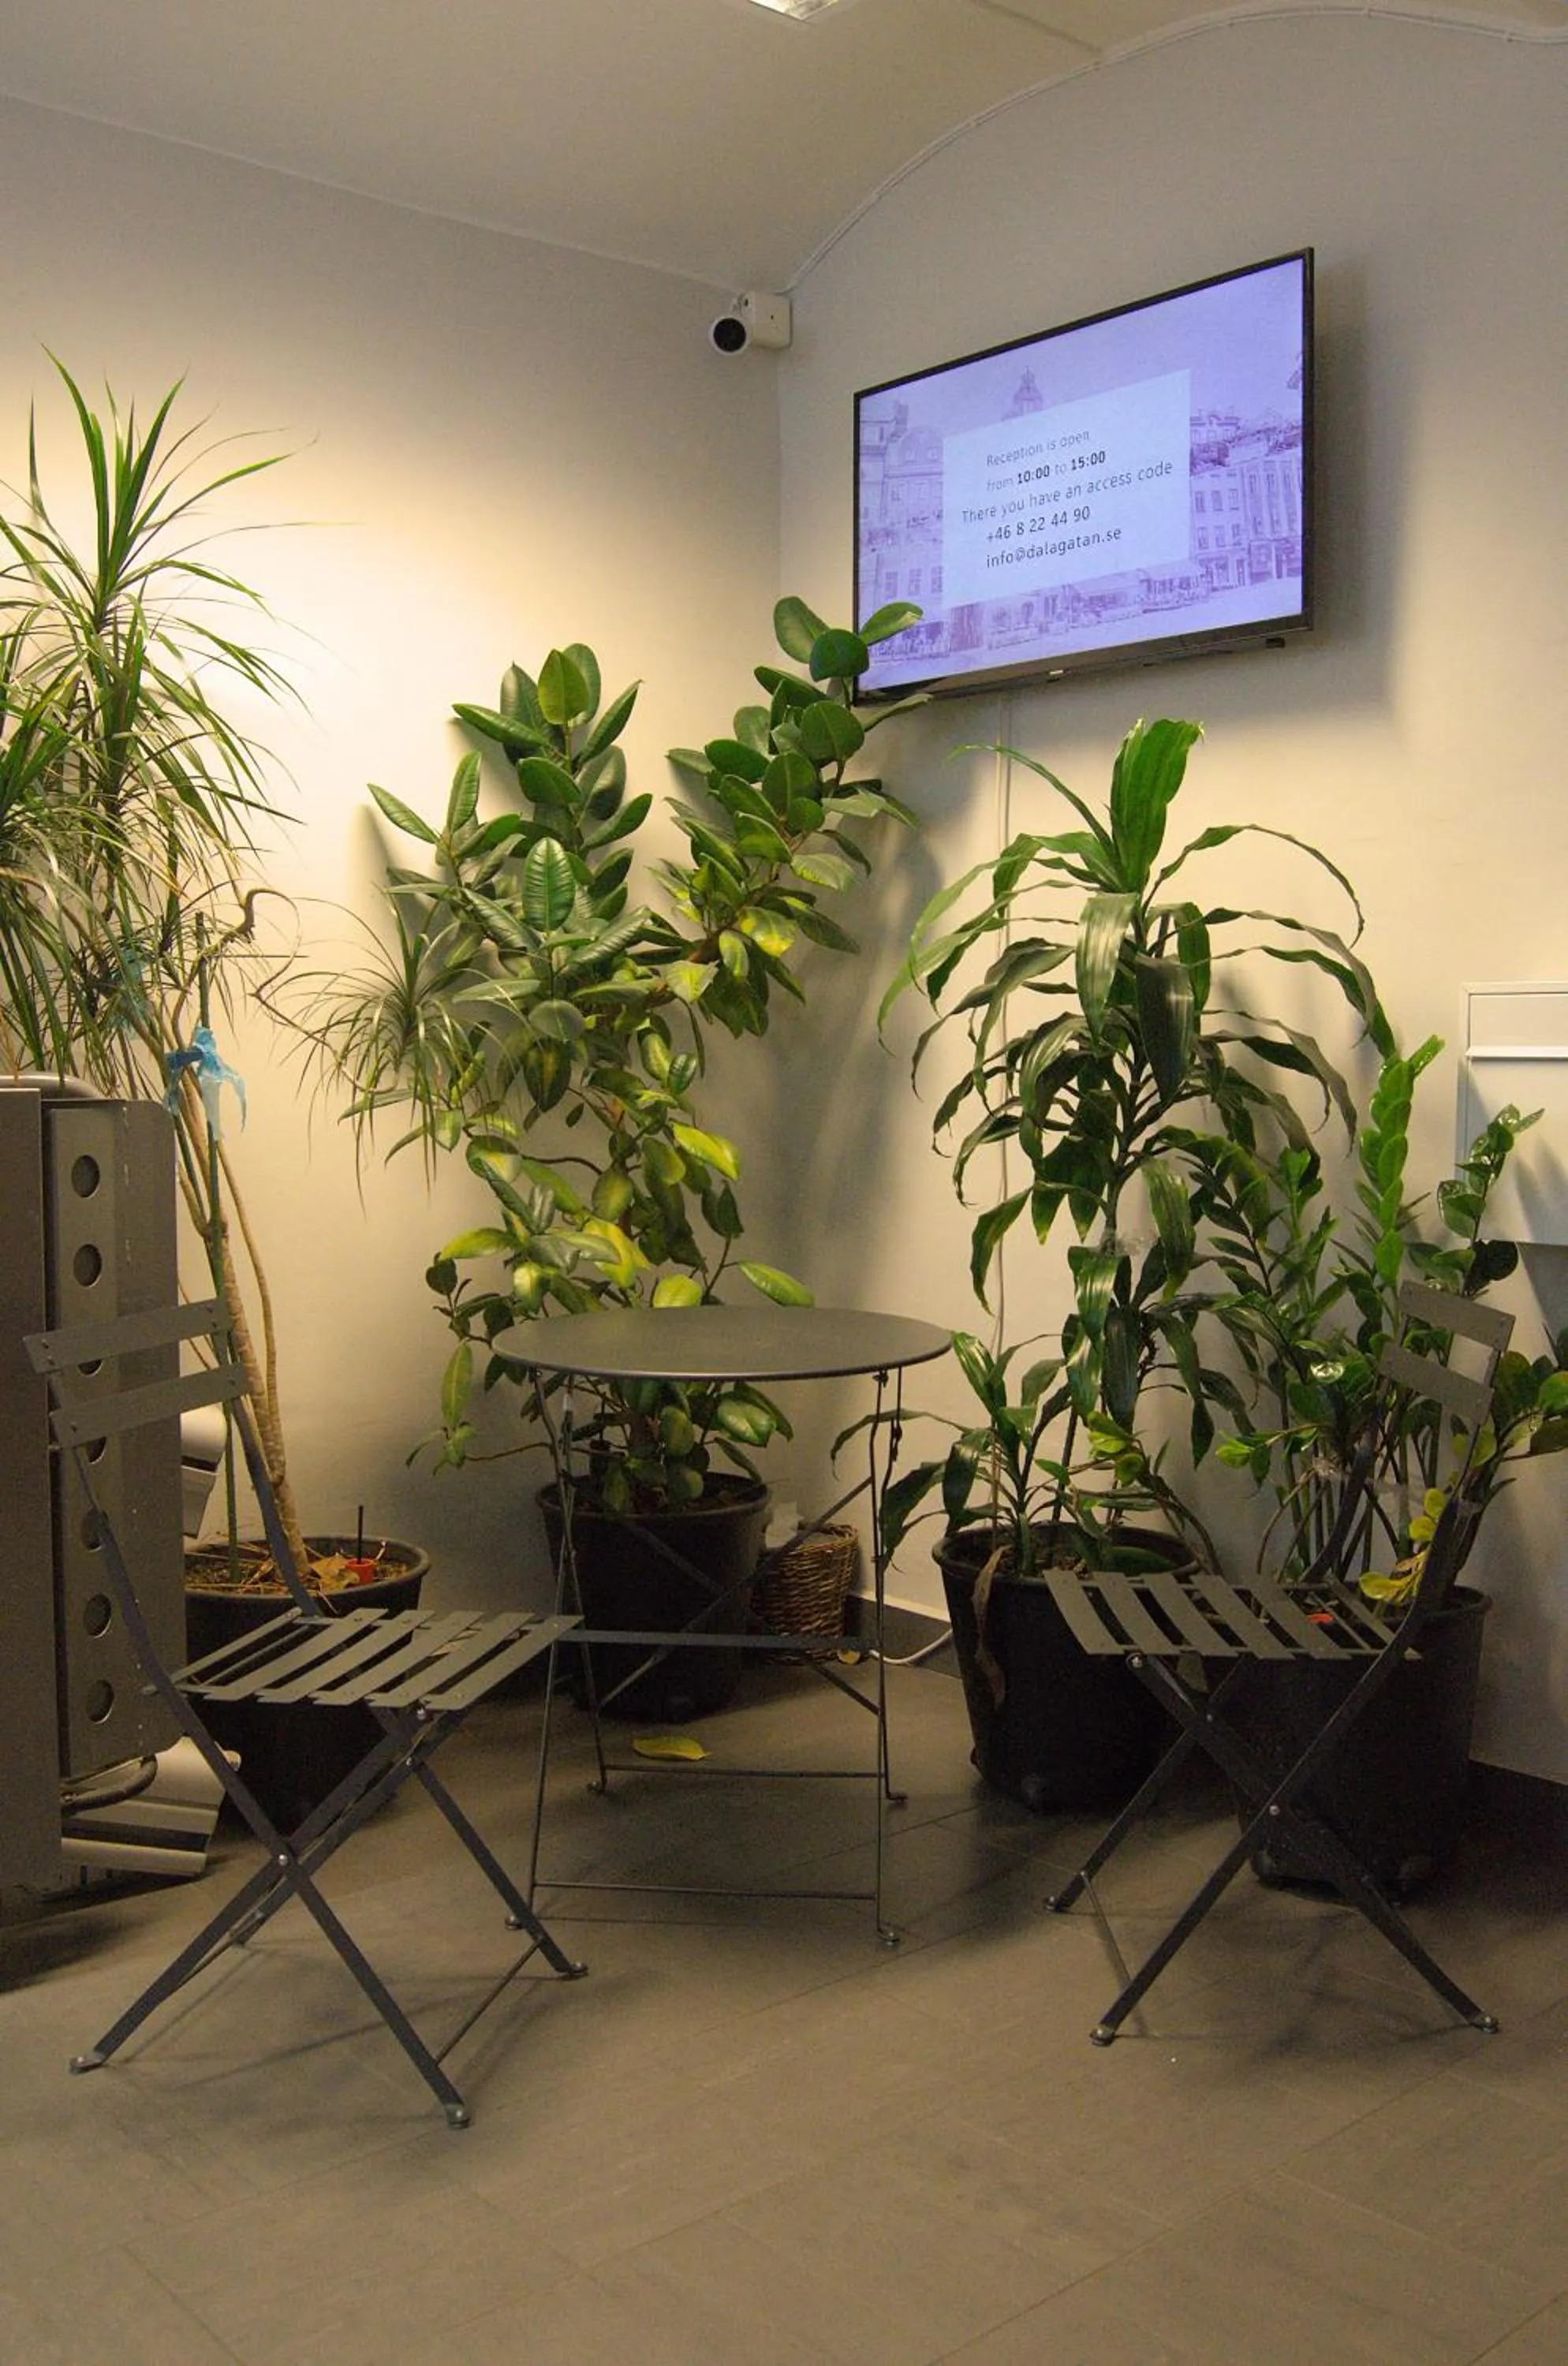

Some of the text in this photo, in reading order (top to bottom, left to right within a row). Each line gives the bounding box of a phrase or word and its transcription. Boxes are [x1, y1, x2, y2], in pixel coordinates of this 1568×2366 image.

[987, 431, 1089, 467] Reception is open
[987, 451, 1106, 491] from 10:00 to 15:00
[962, 461, 1173, 523] There you have an access code
[987, 506, 1090, 542] +46 8 22 44 90
[987, 528, 1122, 568] info@dalagatan.se
